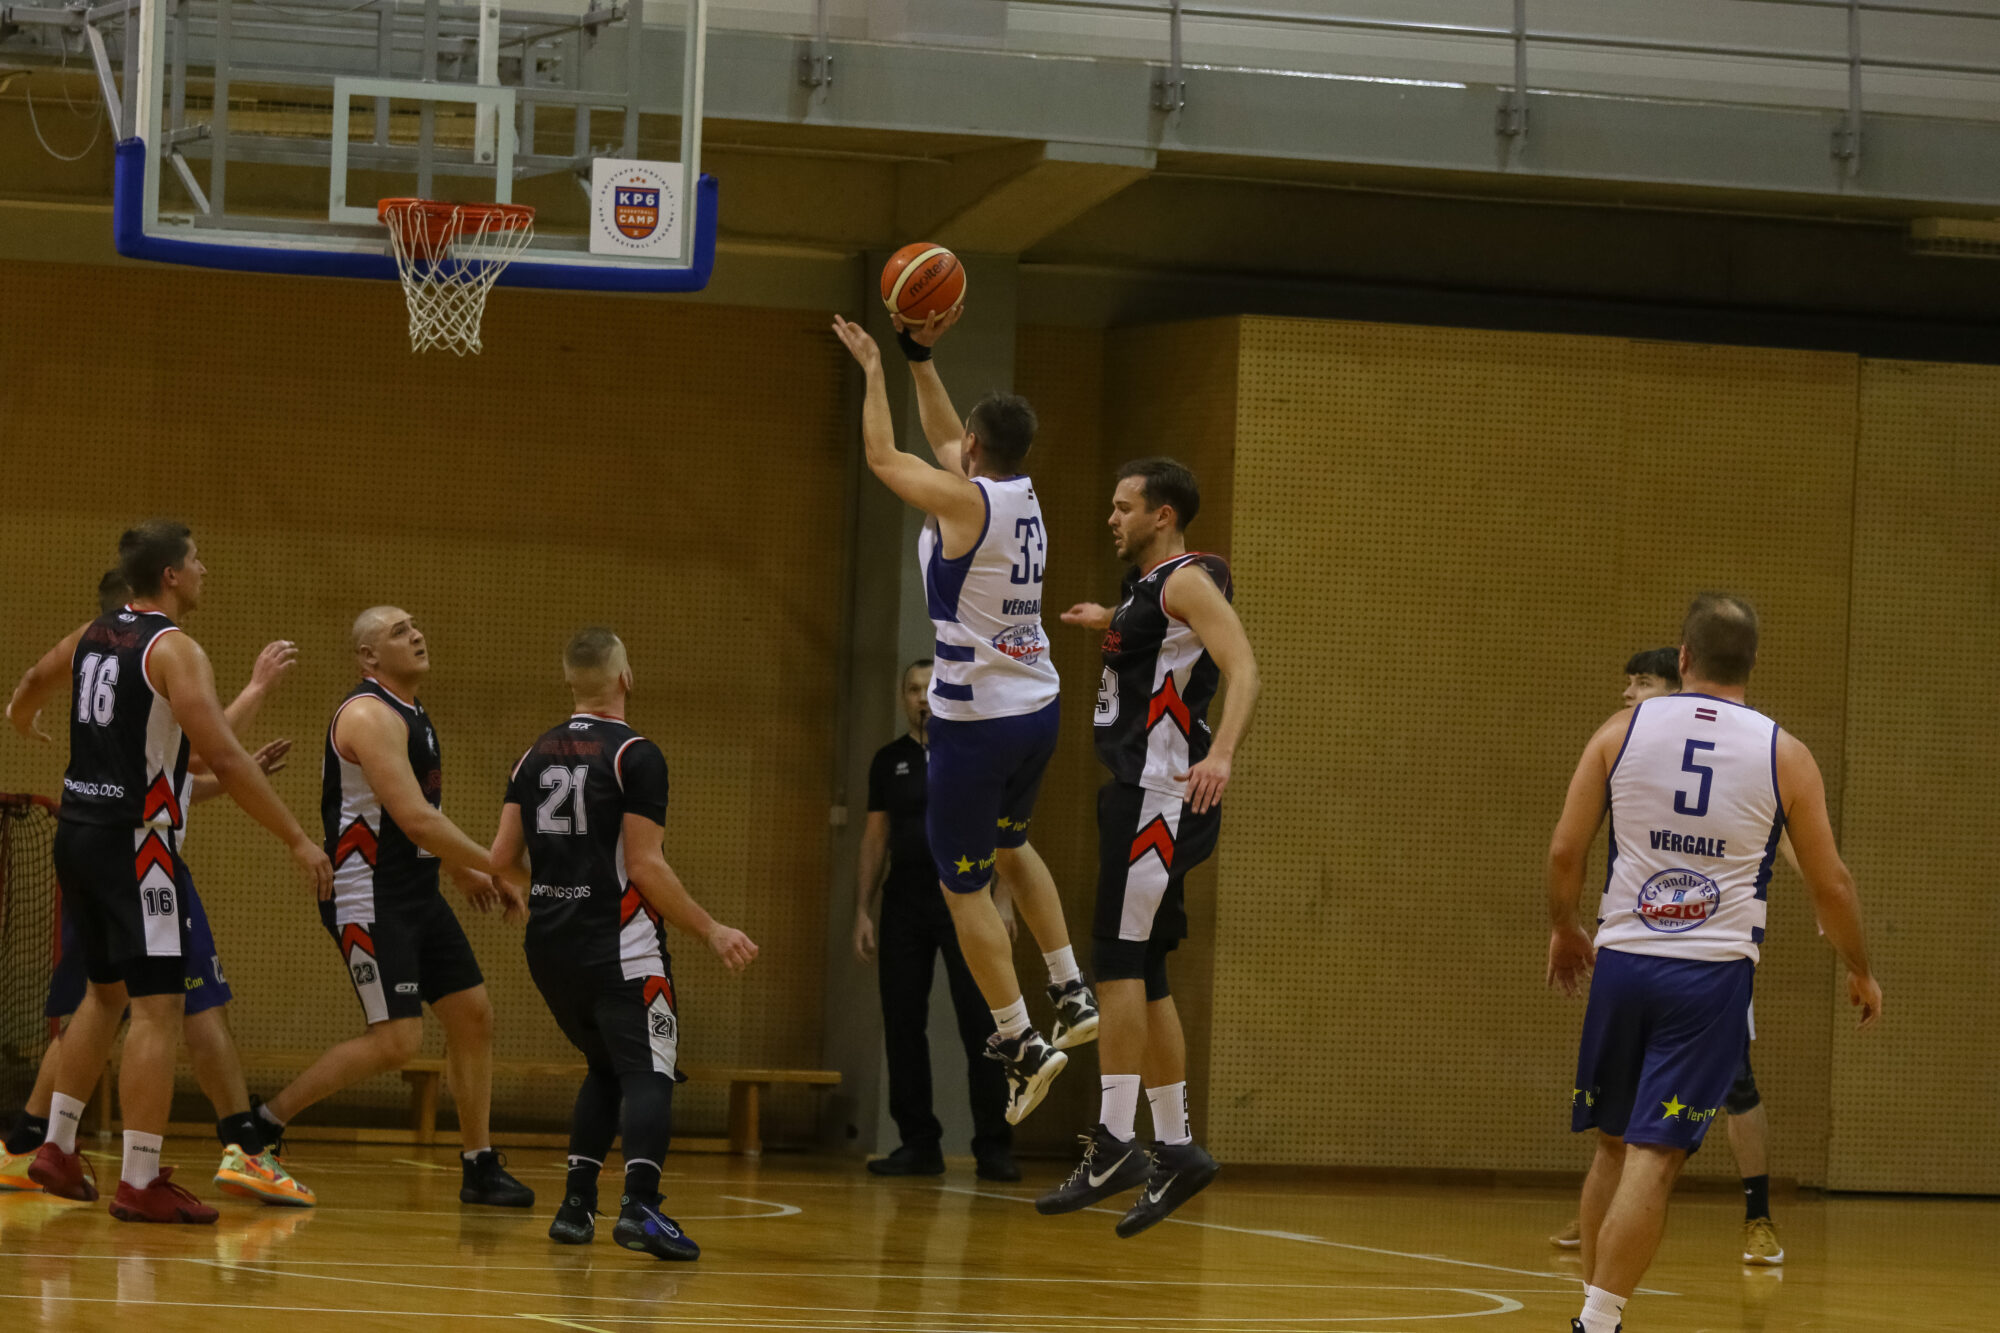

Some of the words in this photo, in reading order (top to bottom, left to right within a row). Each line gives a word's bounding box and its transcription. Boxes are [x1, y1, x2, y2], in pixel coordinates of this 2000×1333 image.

[619, 192, 655, 206] KP6
[619, 214, 655, 224] CAMP
[909, 258, 949, 297] molten
[1010, 516, 1043, 585] 33
[1002, 598, 1040, 615] VĒRGA
[78, 652, 119, 727] 16
[100, 783, 125, 799] ODS
[1674, 738, 1715, 817] 5
[536, 765, 588, 835] 21
[1649, 829, 1727, 858] VĒRGALE
[144, 888, 174, 916] 16
[353, 963, 377, 986] 23
[652, 1013, 675, 1041] 21
